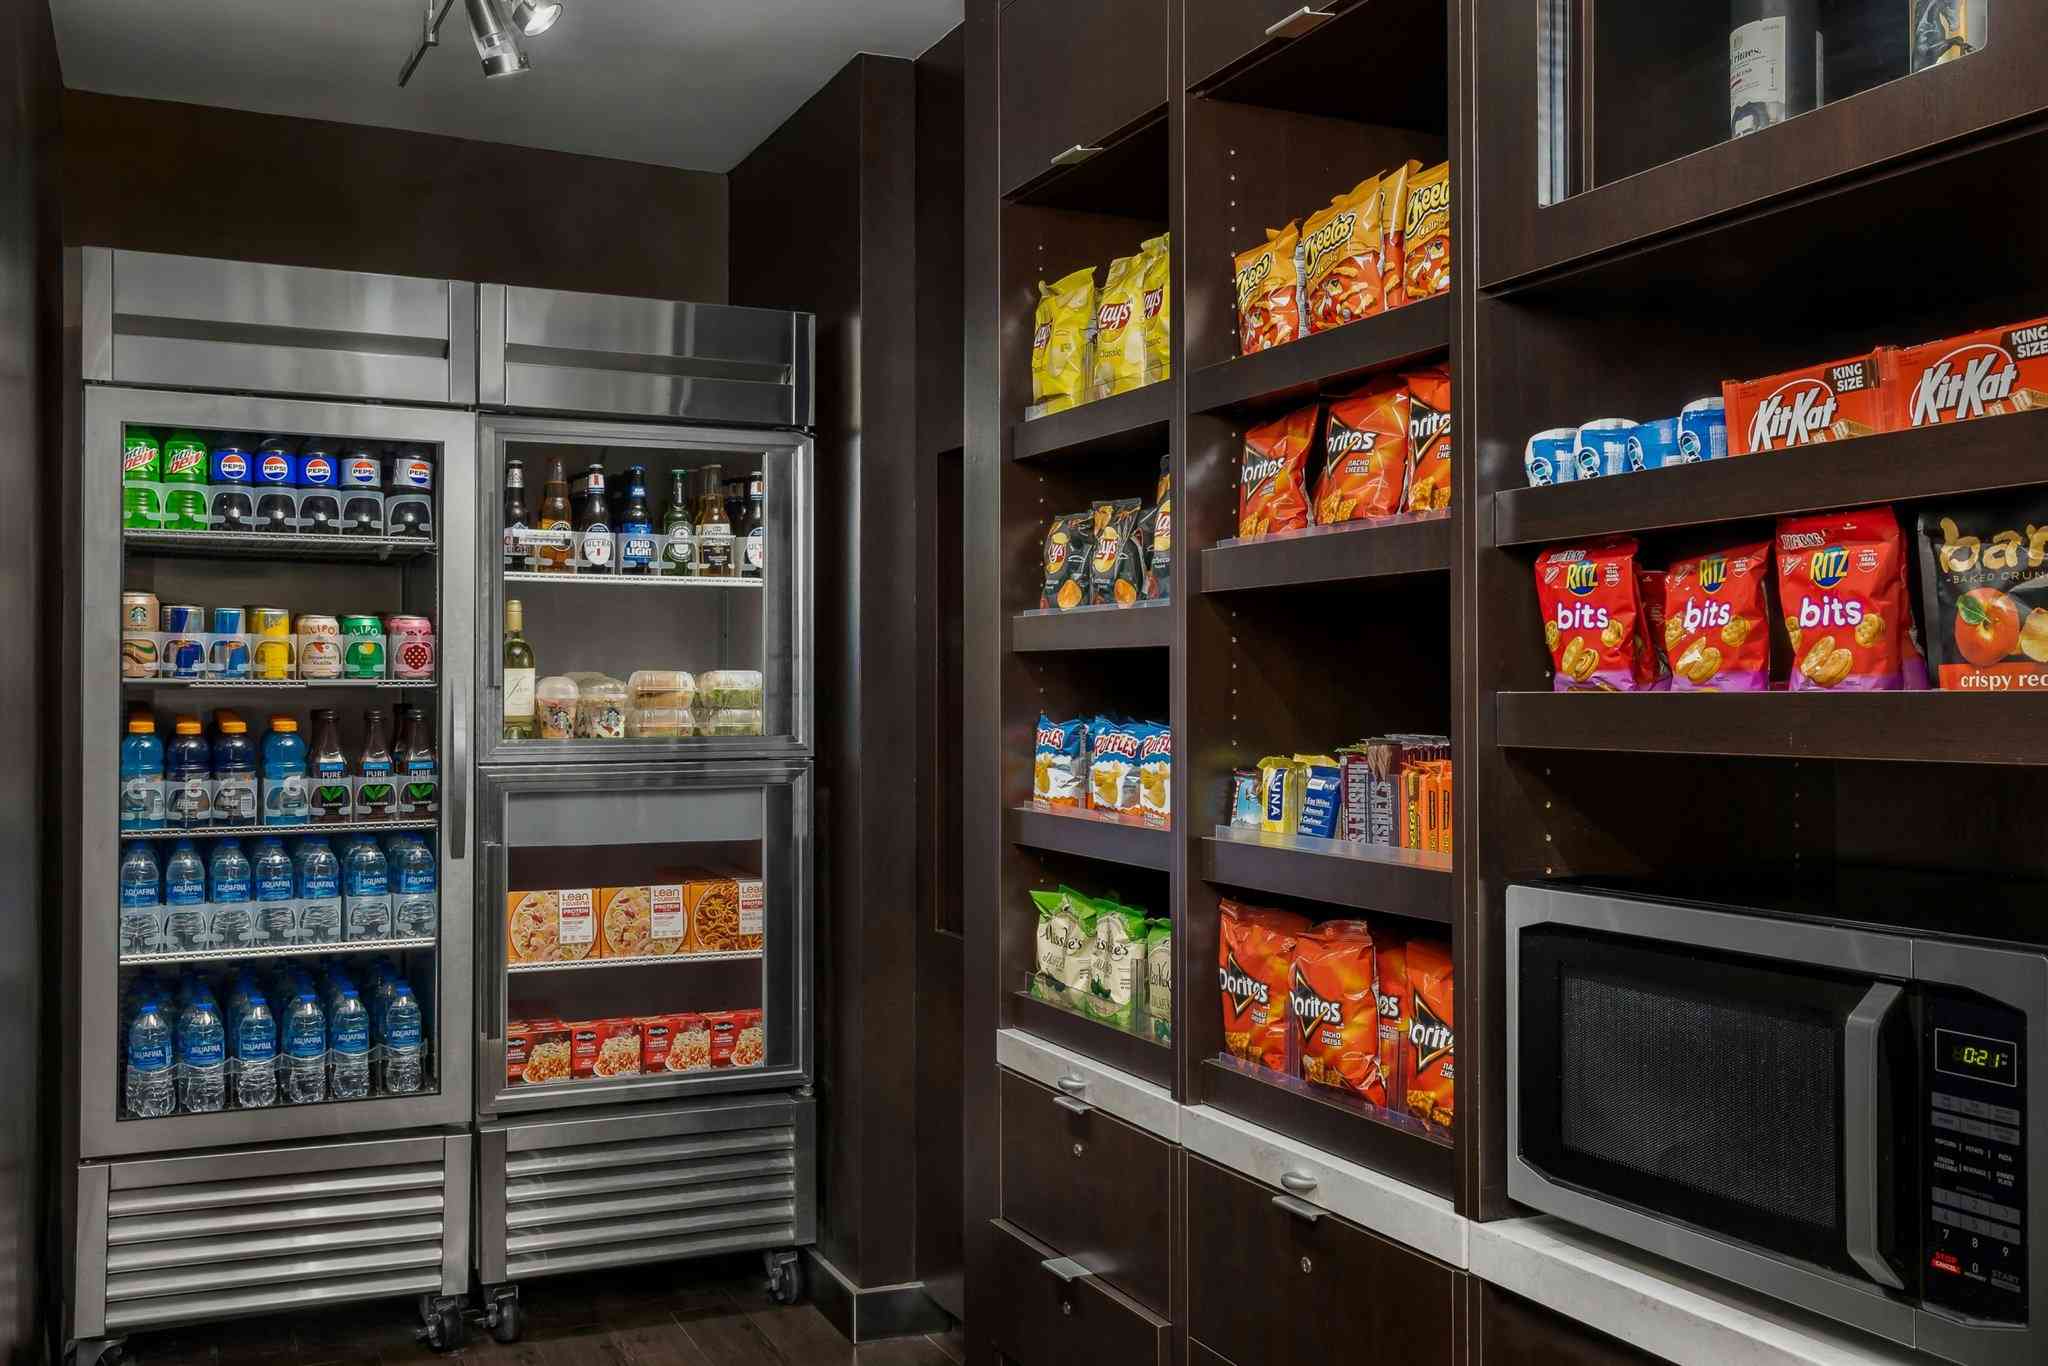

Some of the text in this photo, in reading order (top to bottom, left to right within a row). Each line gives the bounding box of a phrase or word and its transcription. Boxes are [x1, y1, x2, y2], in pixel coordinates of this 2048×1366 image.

[2011, 326, 2048, 345] KING
[2017, 341, 2048, 359] SIZE
[1833, 363, 1862, 380] KING
[1837, 377, 1864, 392] SIZE
[222, 462, 245, 471] PEPSI
[264, 464, 287, 472] PEPSI
[630, 540, 650, 548] BUD
[626, 548, 652, 556] LIGHT
[1810, 550, 1850, 581] RITZ
[1566, 563, 1599, 590] RITZ
[1699, 559, 1728, 587] RITZ
[1952, 573, 1995, 585] BAKED
[1557, 602, 1610, 630] bits
[1683, 598, 1730, 628] bits
[1800, 596, 1861, 627] bits
[1961, 670, 2012, 691] crispy
[1094, 734, 1138, 758] RUFFLES
[322, 770, 342, 778] PURE
[125, 887, 156, 896] AQUAFINA
[562, 892, 589, 901] Lean
[654, 887, 680, 897] Lean
[1963, 1047, 2000, 1068] 0:21
[1943, 1228, 1950, 1240] 7
[1971, 1237, 1979, 1248] 8
[2002, 1246, 2009, 1257] 9
[1972, 1262, 1979, 1273] 0
